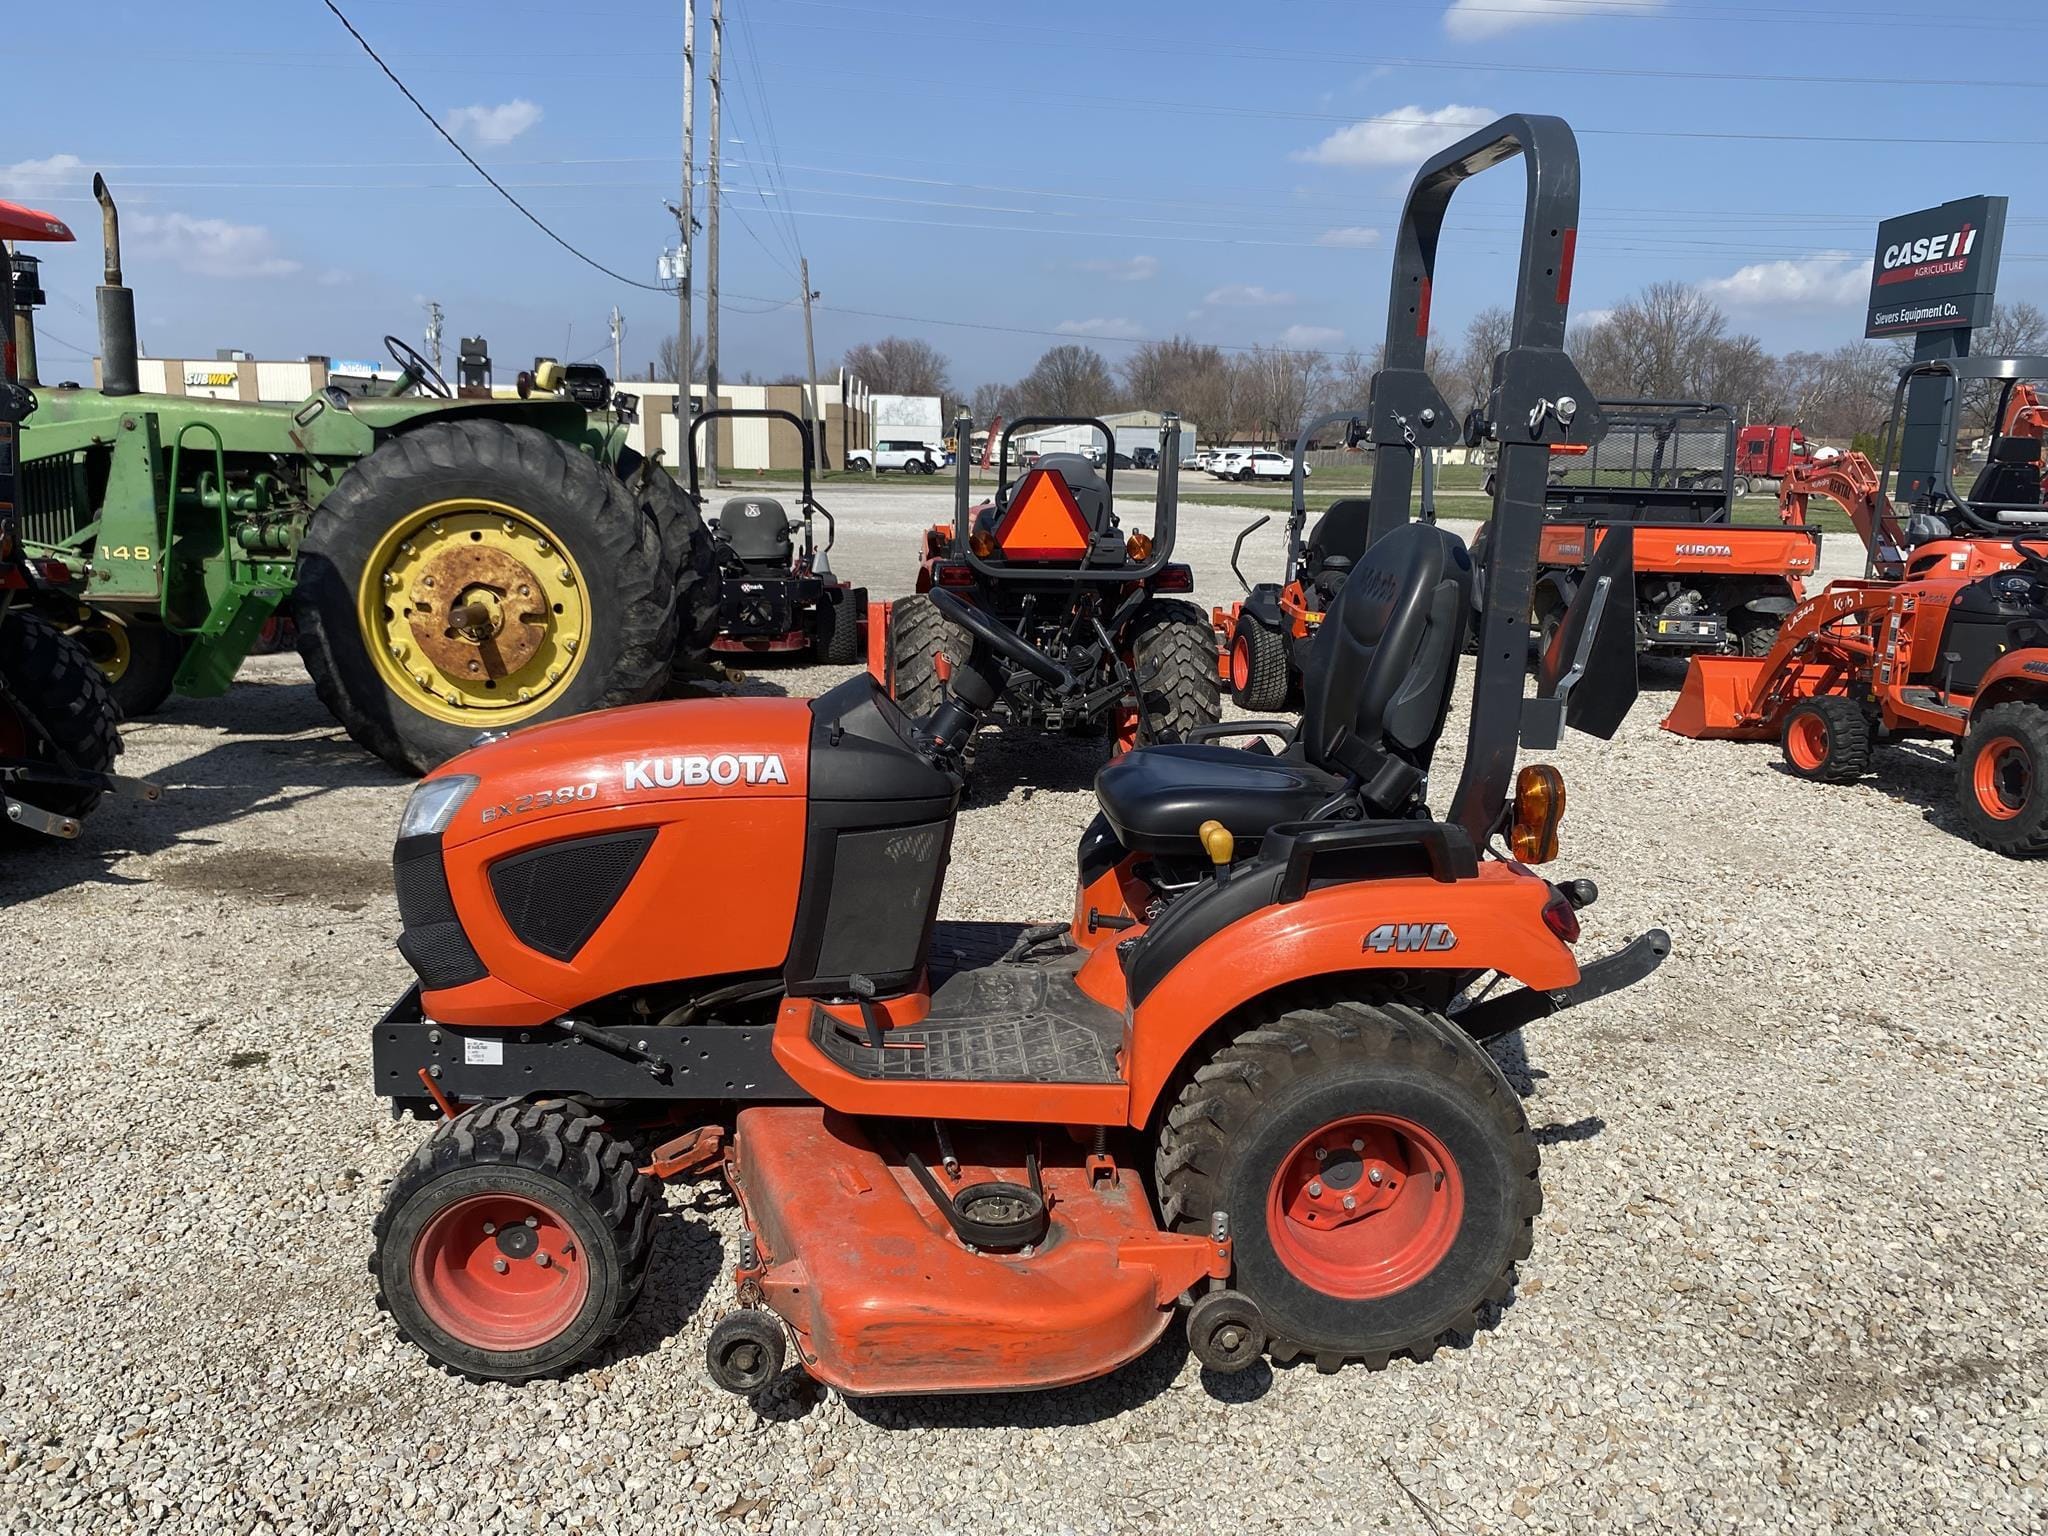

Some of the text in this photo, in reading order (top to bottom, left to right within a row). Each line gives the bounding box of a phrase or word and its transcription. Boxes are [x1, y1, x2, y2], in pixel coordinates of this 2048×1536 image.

[1883, 234, 1949, 269] CASE
[1914, 260, 1964, 277] AGRICULTURE
[1874, 302, 1959, 325] Sievers Equipment Co.
[184, 373, 238, 386] SUBWAY
[101, 545, 150, 561] 148
[1675, 544, 1732, 557] KUBOTA
[1787, 603, 1815, 631] LA344
[623, 754, 790, 791] KUBOTA
[481, 783, 599, 824] BX2380
[1362, 923, 1458, 953] 4WD
